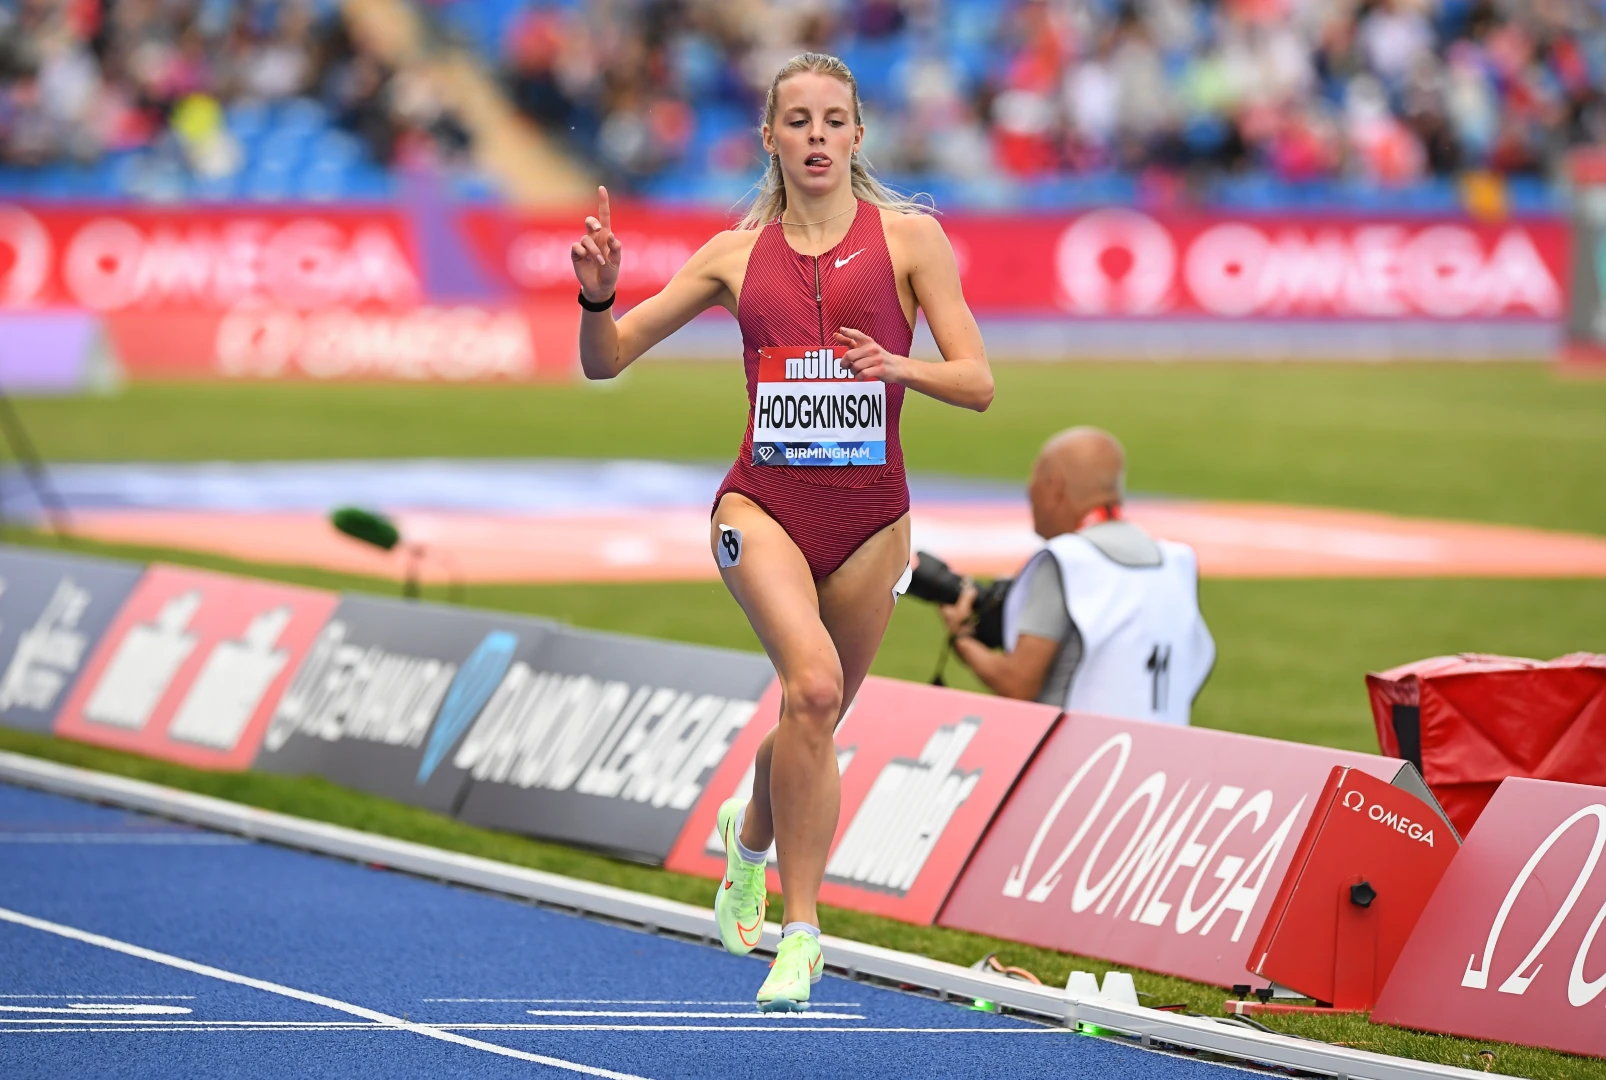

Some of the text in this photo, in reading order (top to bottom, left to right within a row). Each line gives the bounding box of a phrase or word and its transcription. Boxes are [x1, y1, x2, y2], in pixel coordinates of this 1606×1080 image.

[1183, 222, 1565, 318] OMEGA
[758, 394, 882, 429] HODGKINSON
[785, 447, 870, 459] BIRMINGHAM
[722, 529, 739, 562] 8
[1368, 804, 1434, 848] OMEGA
[1071, 771, 1308, 943] OMEGA
